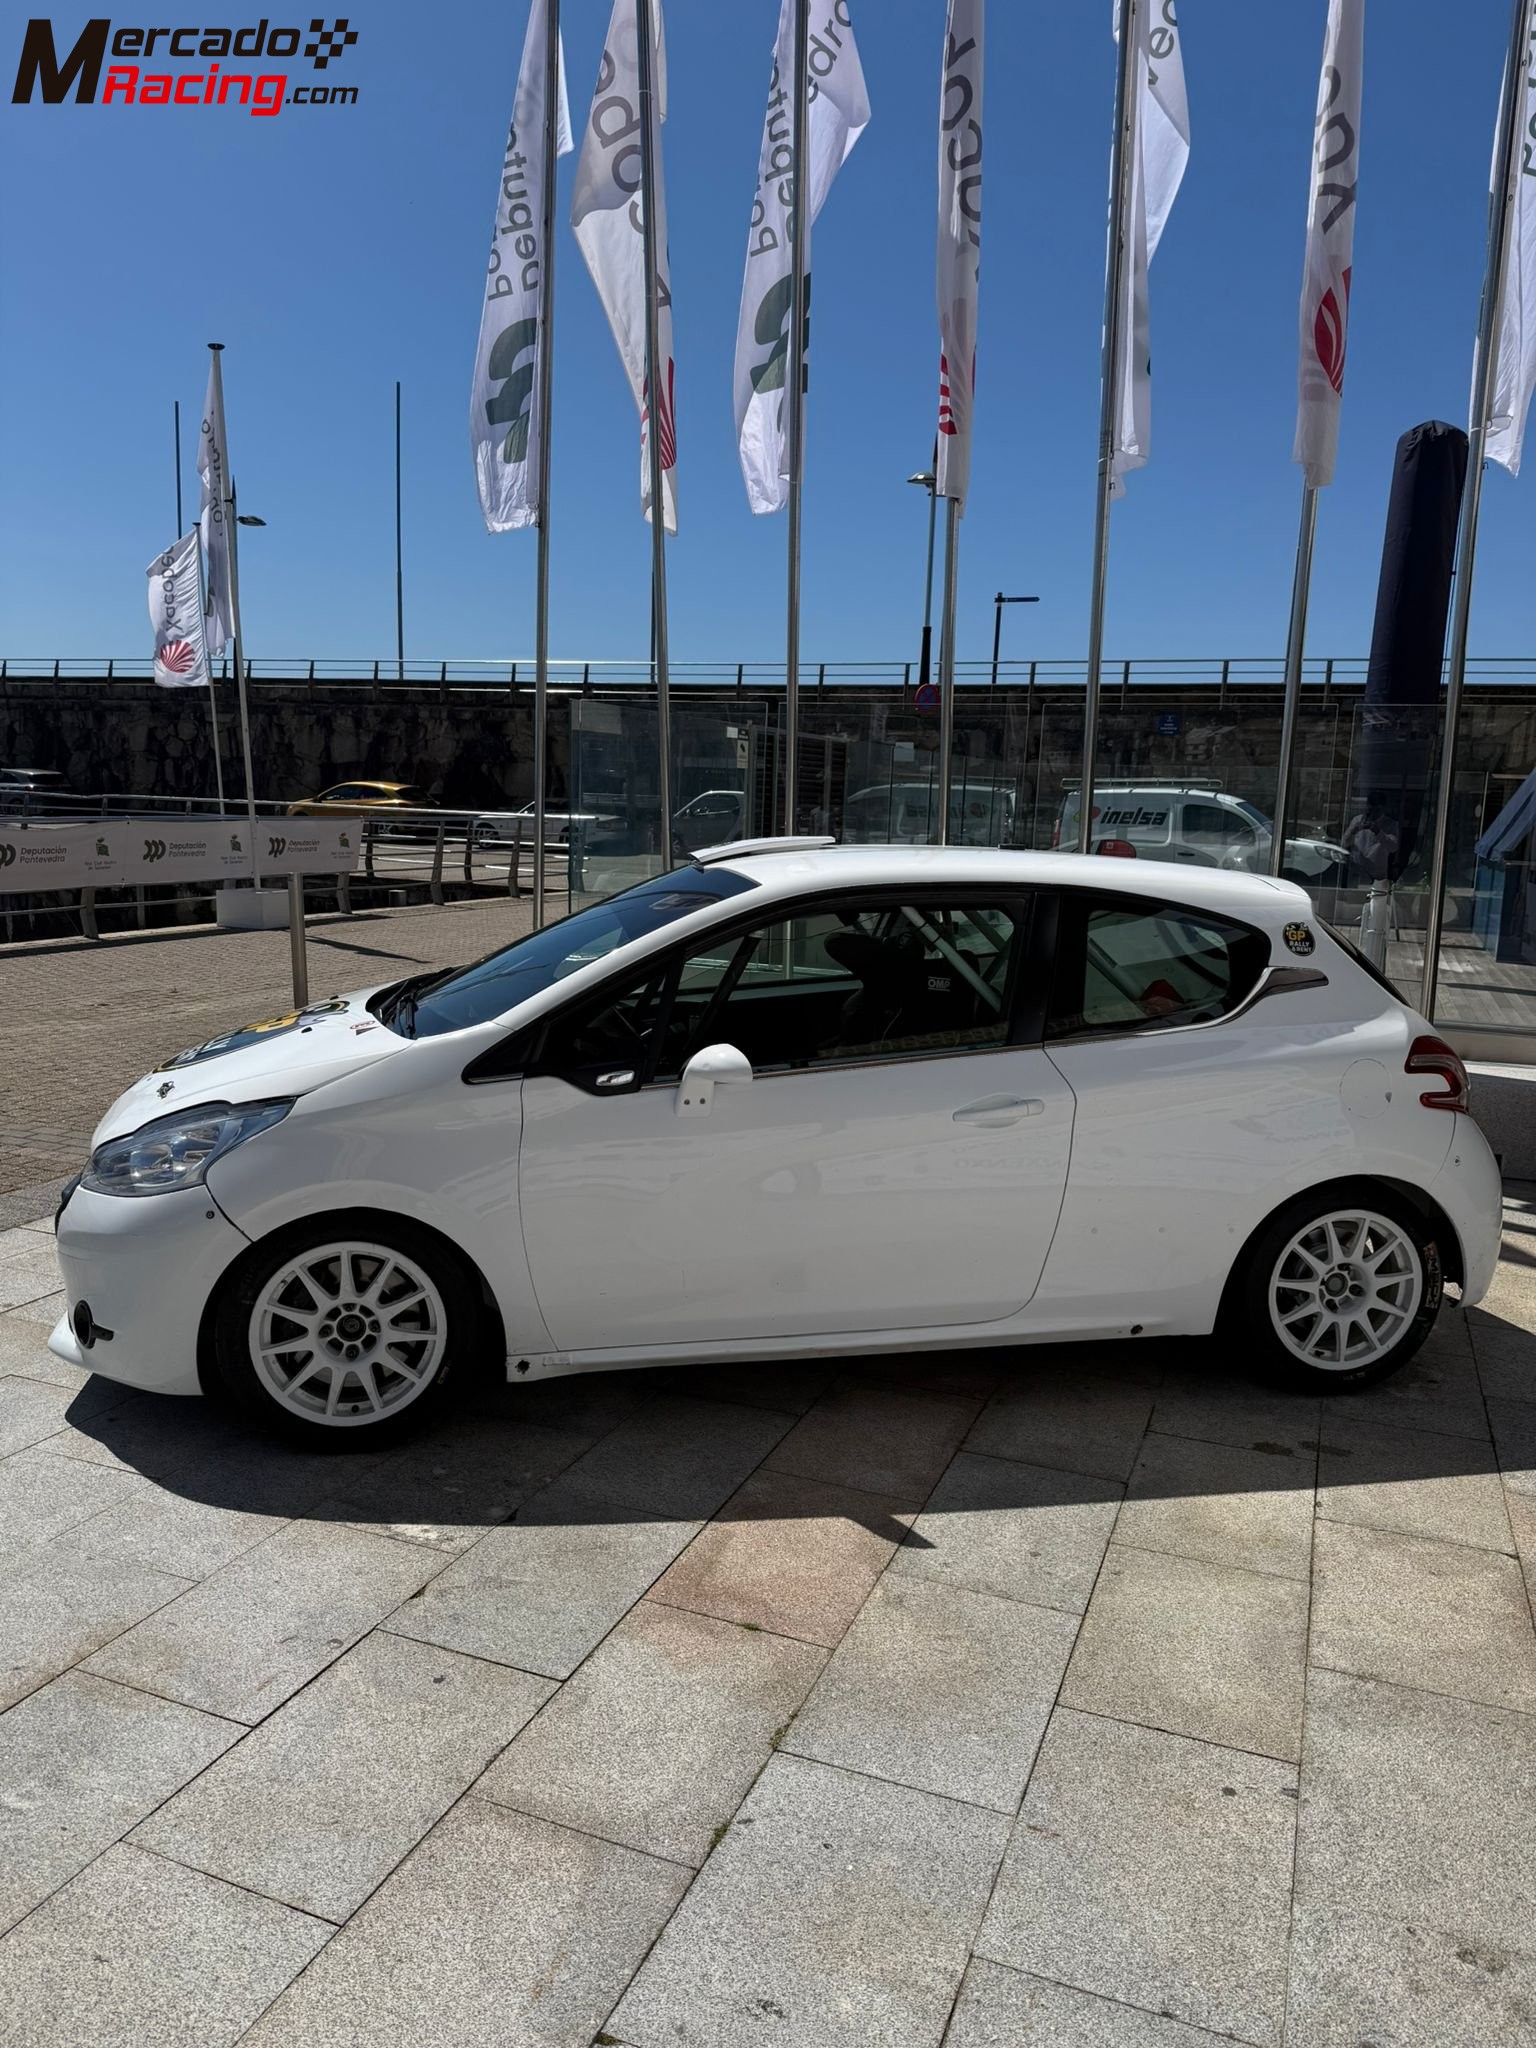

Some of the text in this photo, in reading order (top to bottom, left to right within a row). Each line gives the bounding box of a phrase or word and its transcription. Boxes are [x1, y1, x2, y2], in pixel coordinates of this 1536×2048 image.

[1100, 806, 1168, 825] inelsa
[20, 845, 67, 856] Deputación
[20, 856, 65, 864] Pontevedra
[1288, 930, 1306, 941] GP
[927, 978, 951, 989] OMP
